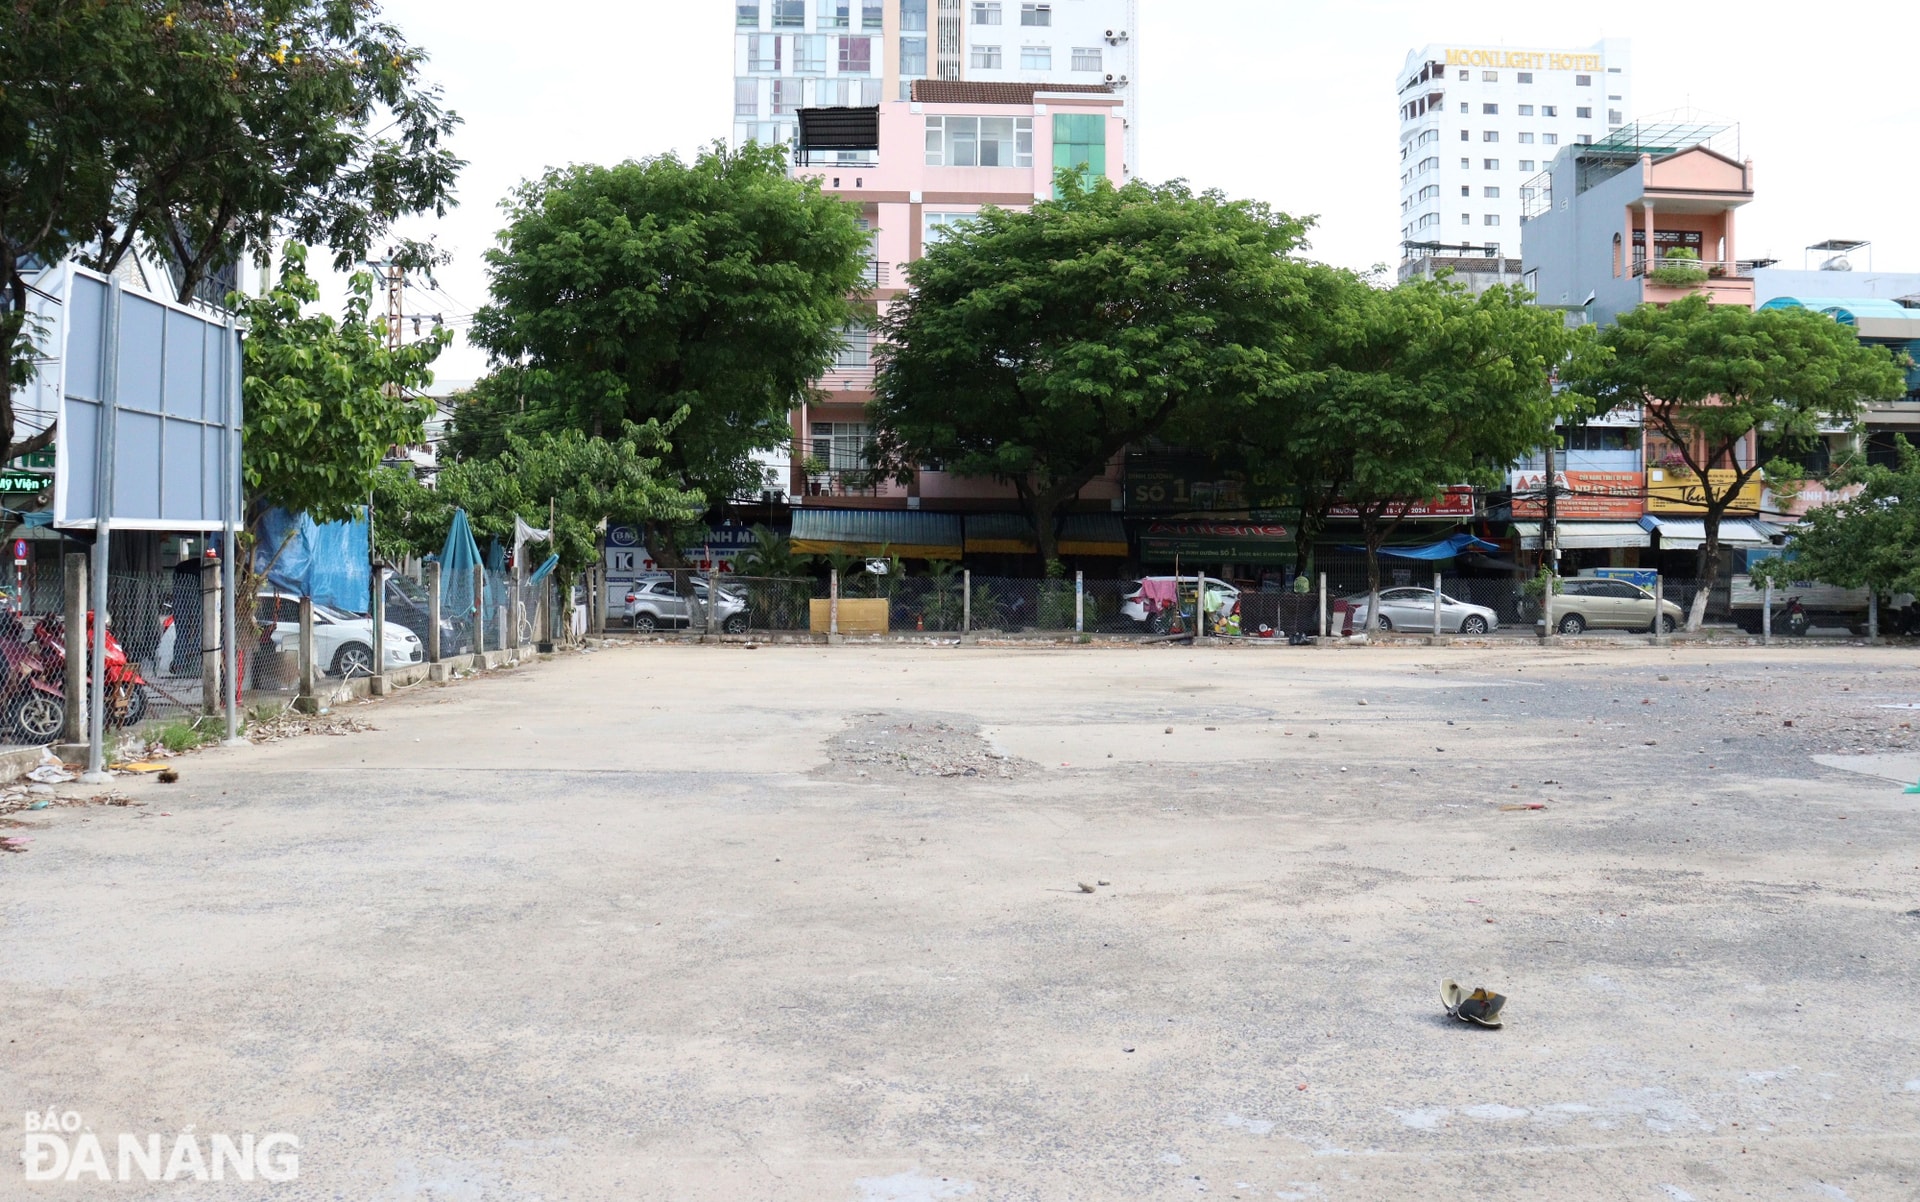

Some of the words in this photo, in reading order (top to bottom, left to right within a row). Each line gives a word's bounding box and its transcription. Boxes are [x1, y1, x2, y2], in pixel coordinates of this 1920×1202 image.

[1445, 48, 1545, 70] MOONLIGHT
[1549, 53, 1604, 72] HOTEL
[14, 478, 39, 491] Viện
[1173, 478, 1190, 503] 1
